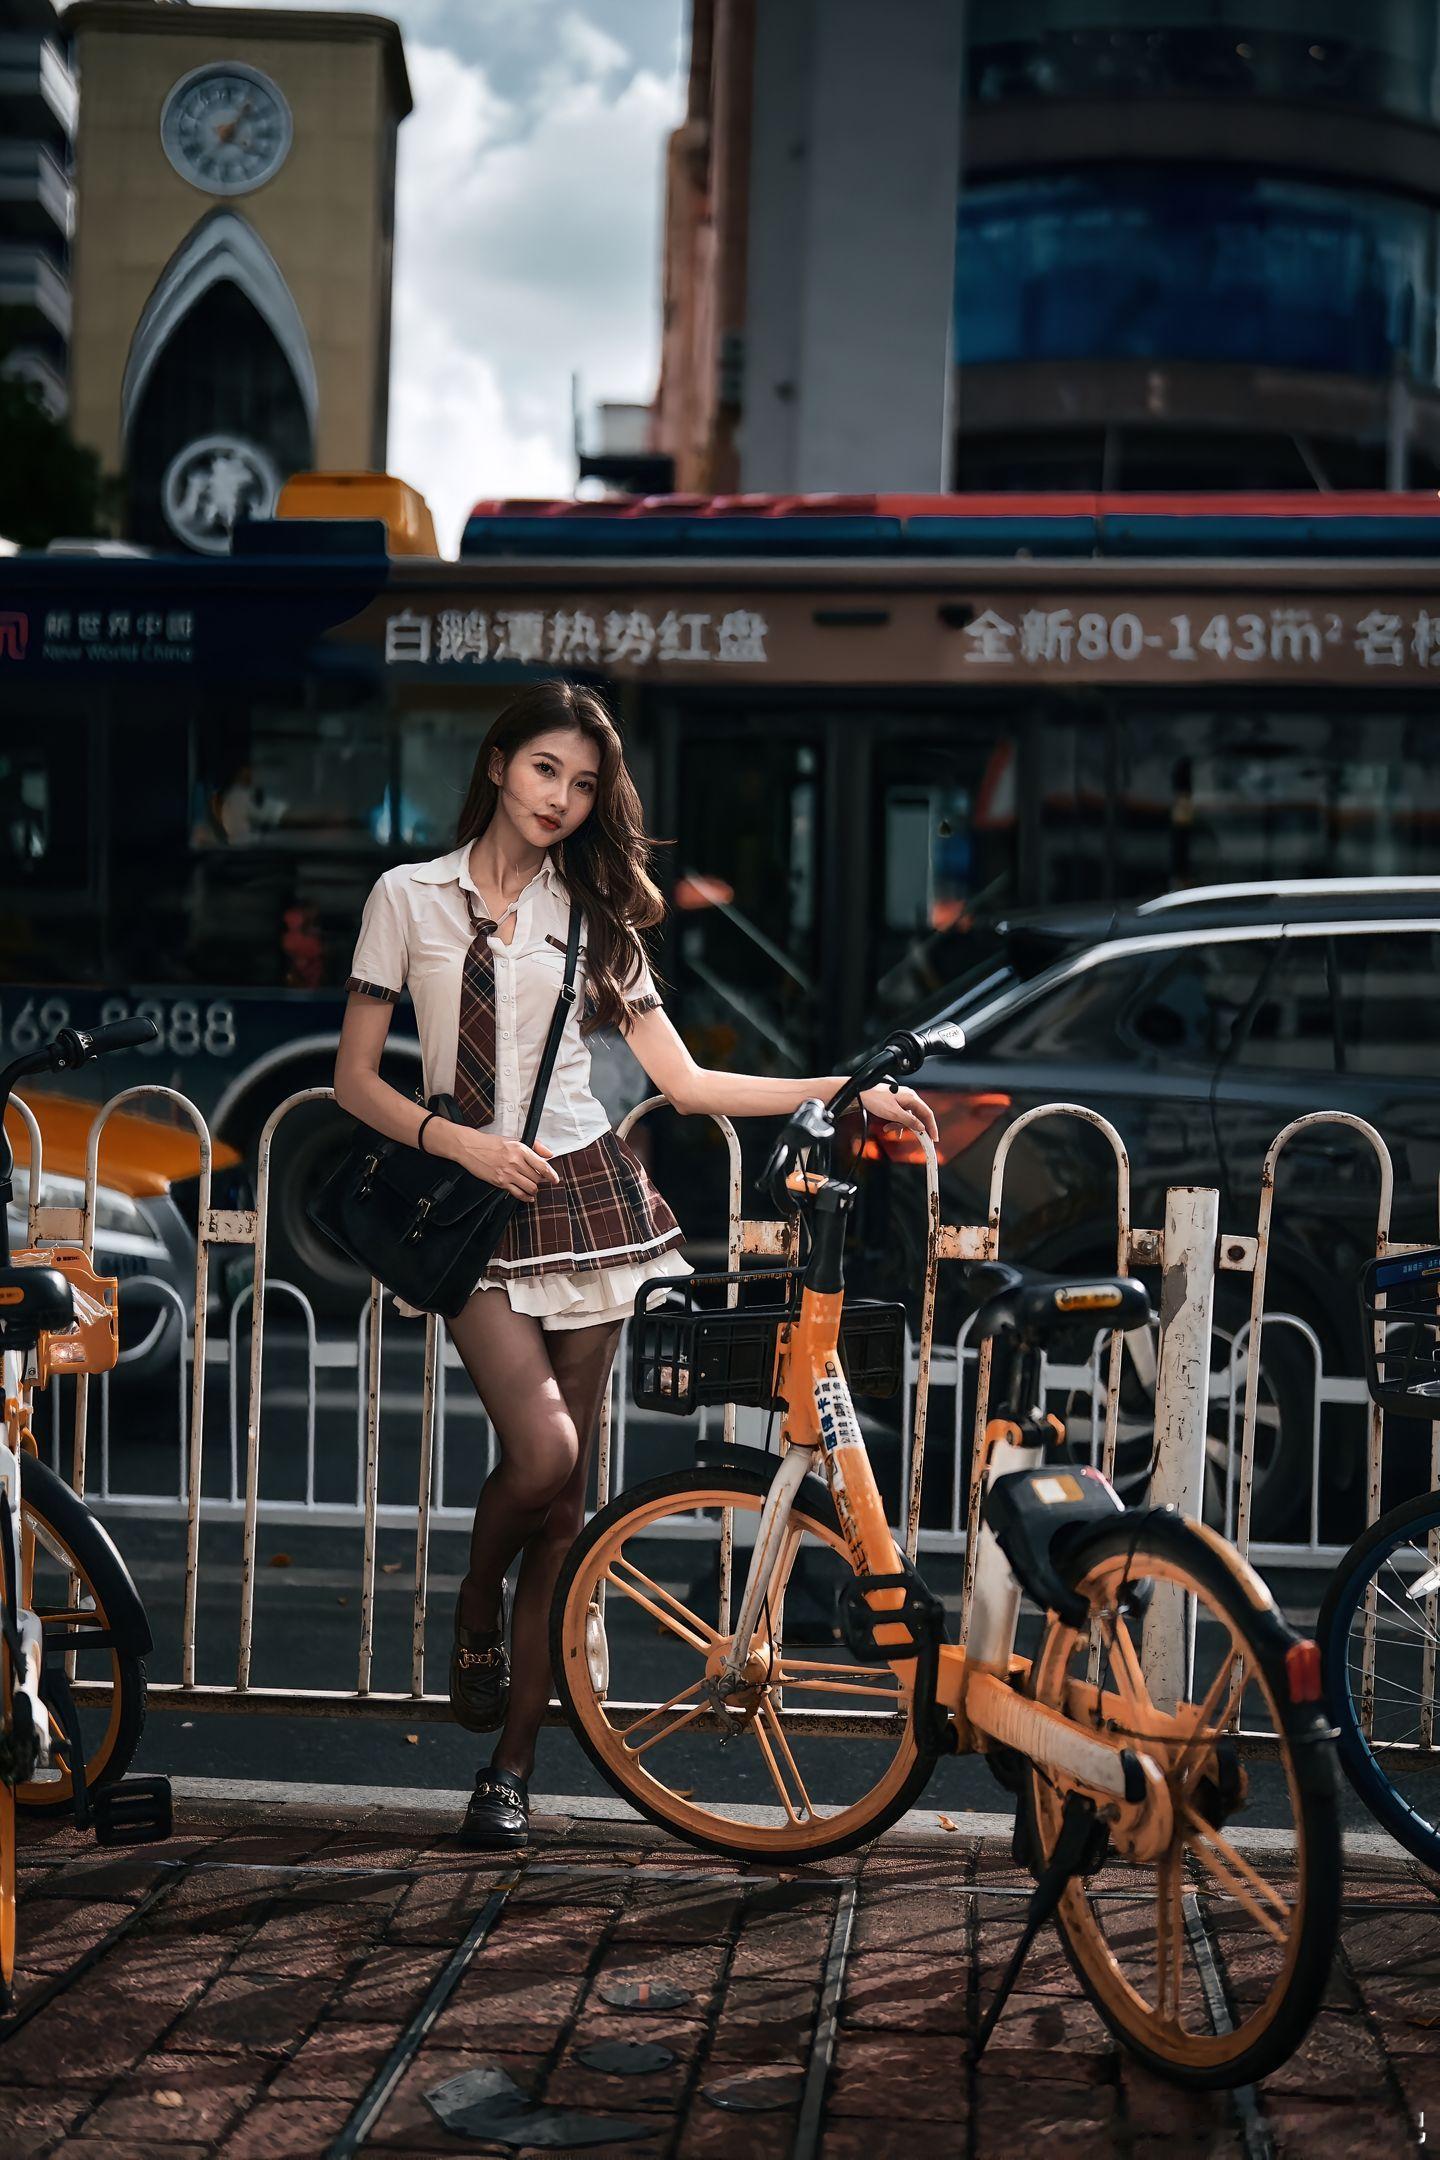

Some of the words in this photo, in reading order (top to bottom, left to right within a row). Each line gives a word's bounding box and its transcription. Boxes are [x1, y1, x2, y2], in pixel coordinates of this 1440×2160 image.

[385, 608, 768, 665] 白鹅潭热势红盘
